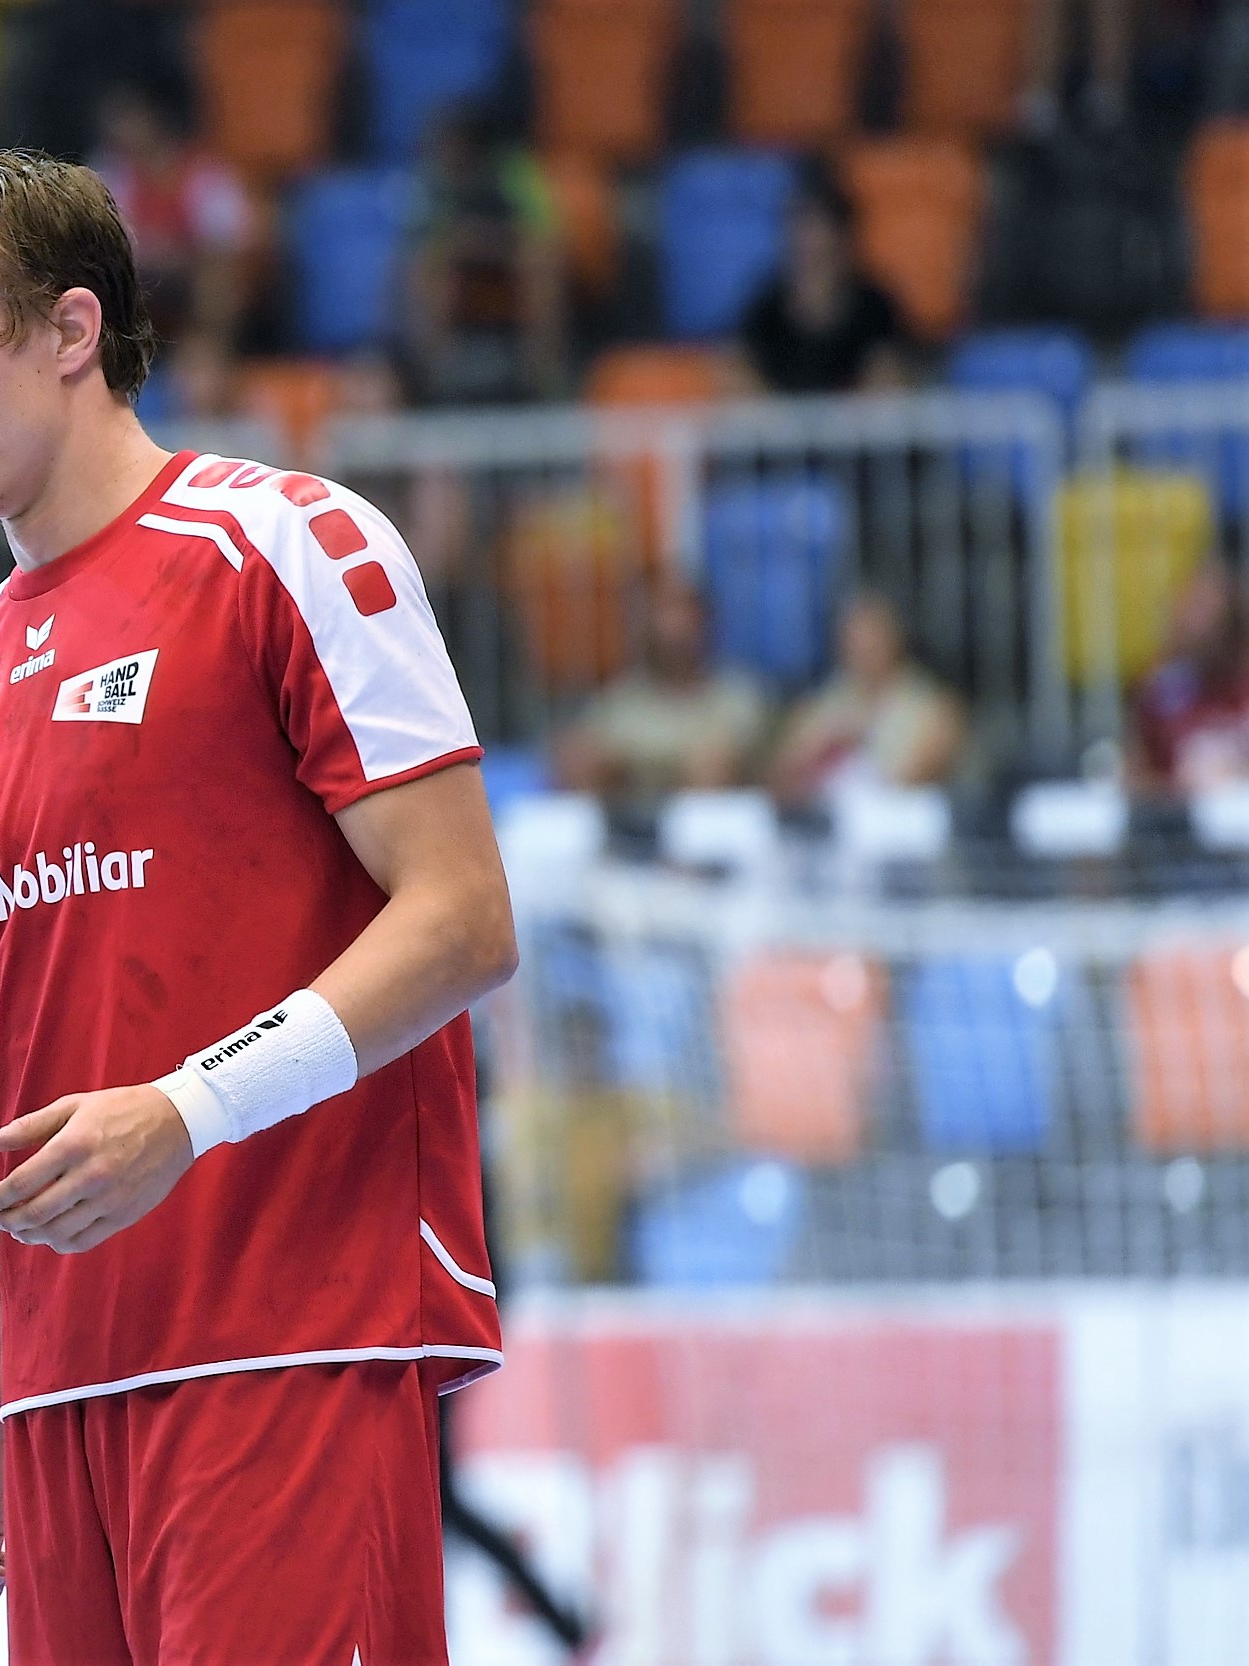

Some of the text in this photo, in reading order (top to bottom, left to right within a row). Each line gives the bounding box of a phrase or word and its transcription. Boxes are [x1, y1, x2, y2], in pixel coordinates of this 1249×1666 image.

[9, 648, 56, 685] erima
[100, 661, 139, 688] HAND
[104, 680, 136, 699] BALL
[200, 1030, 262, 1071] erima
